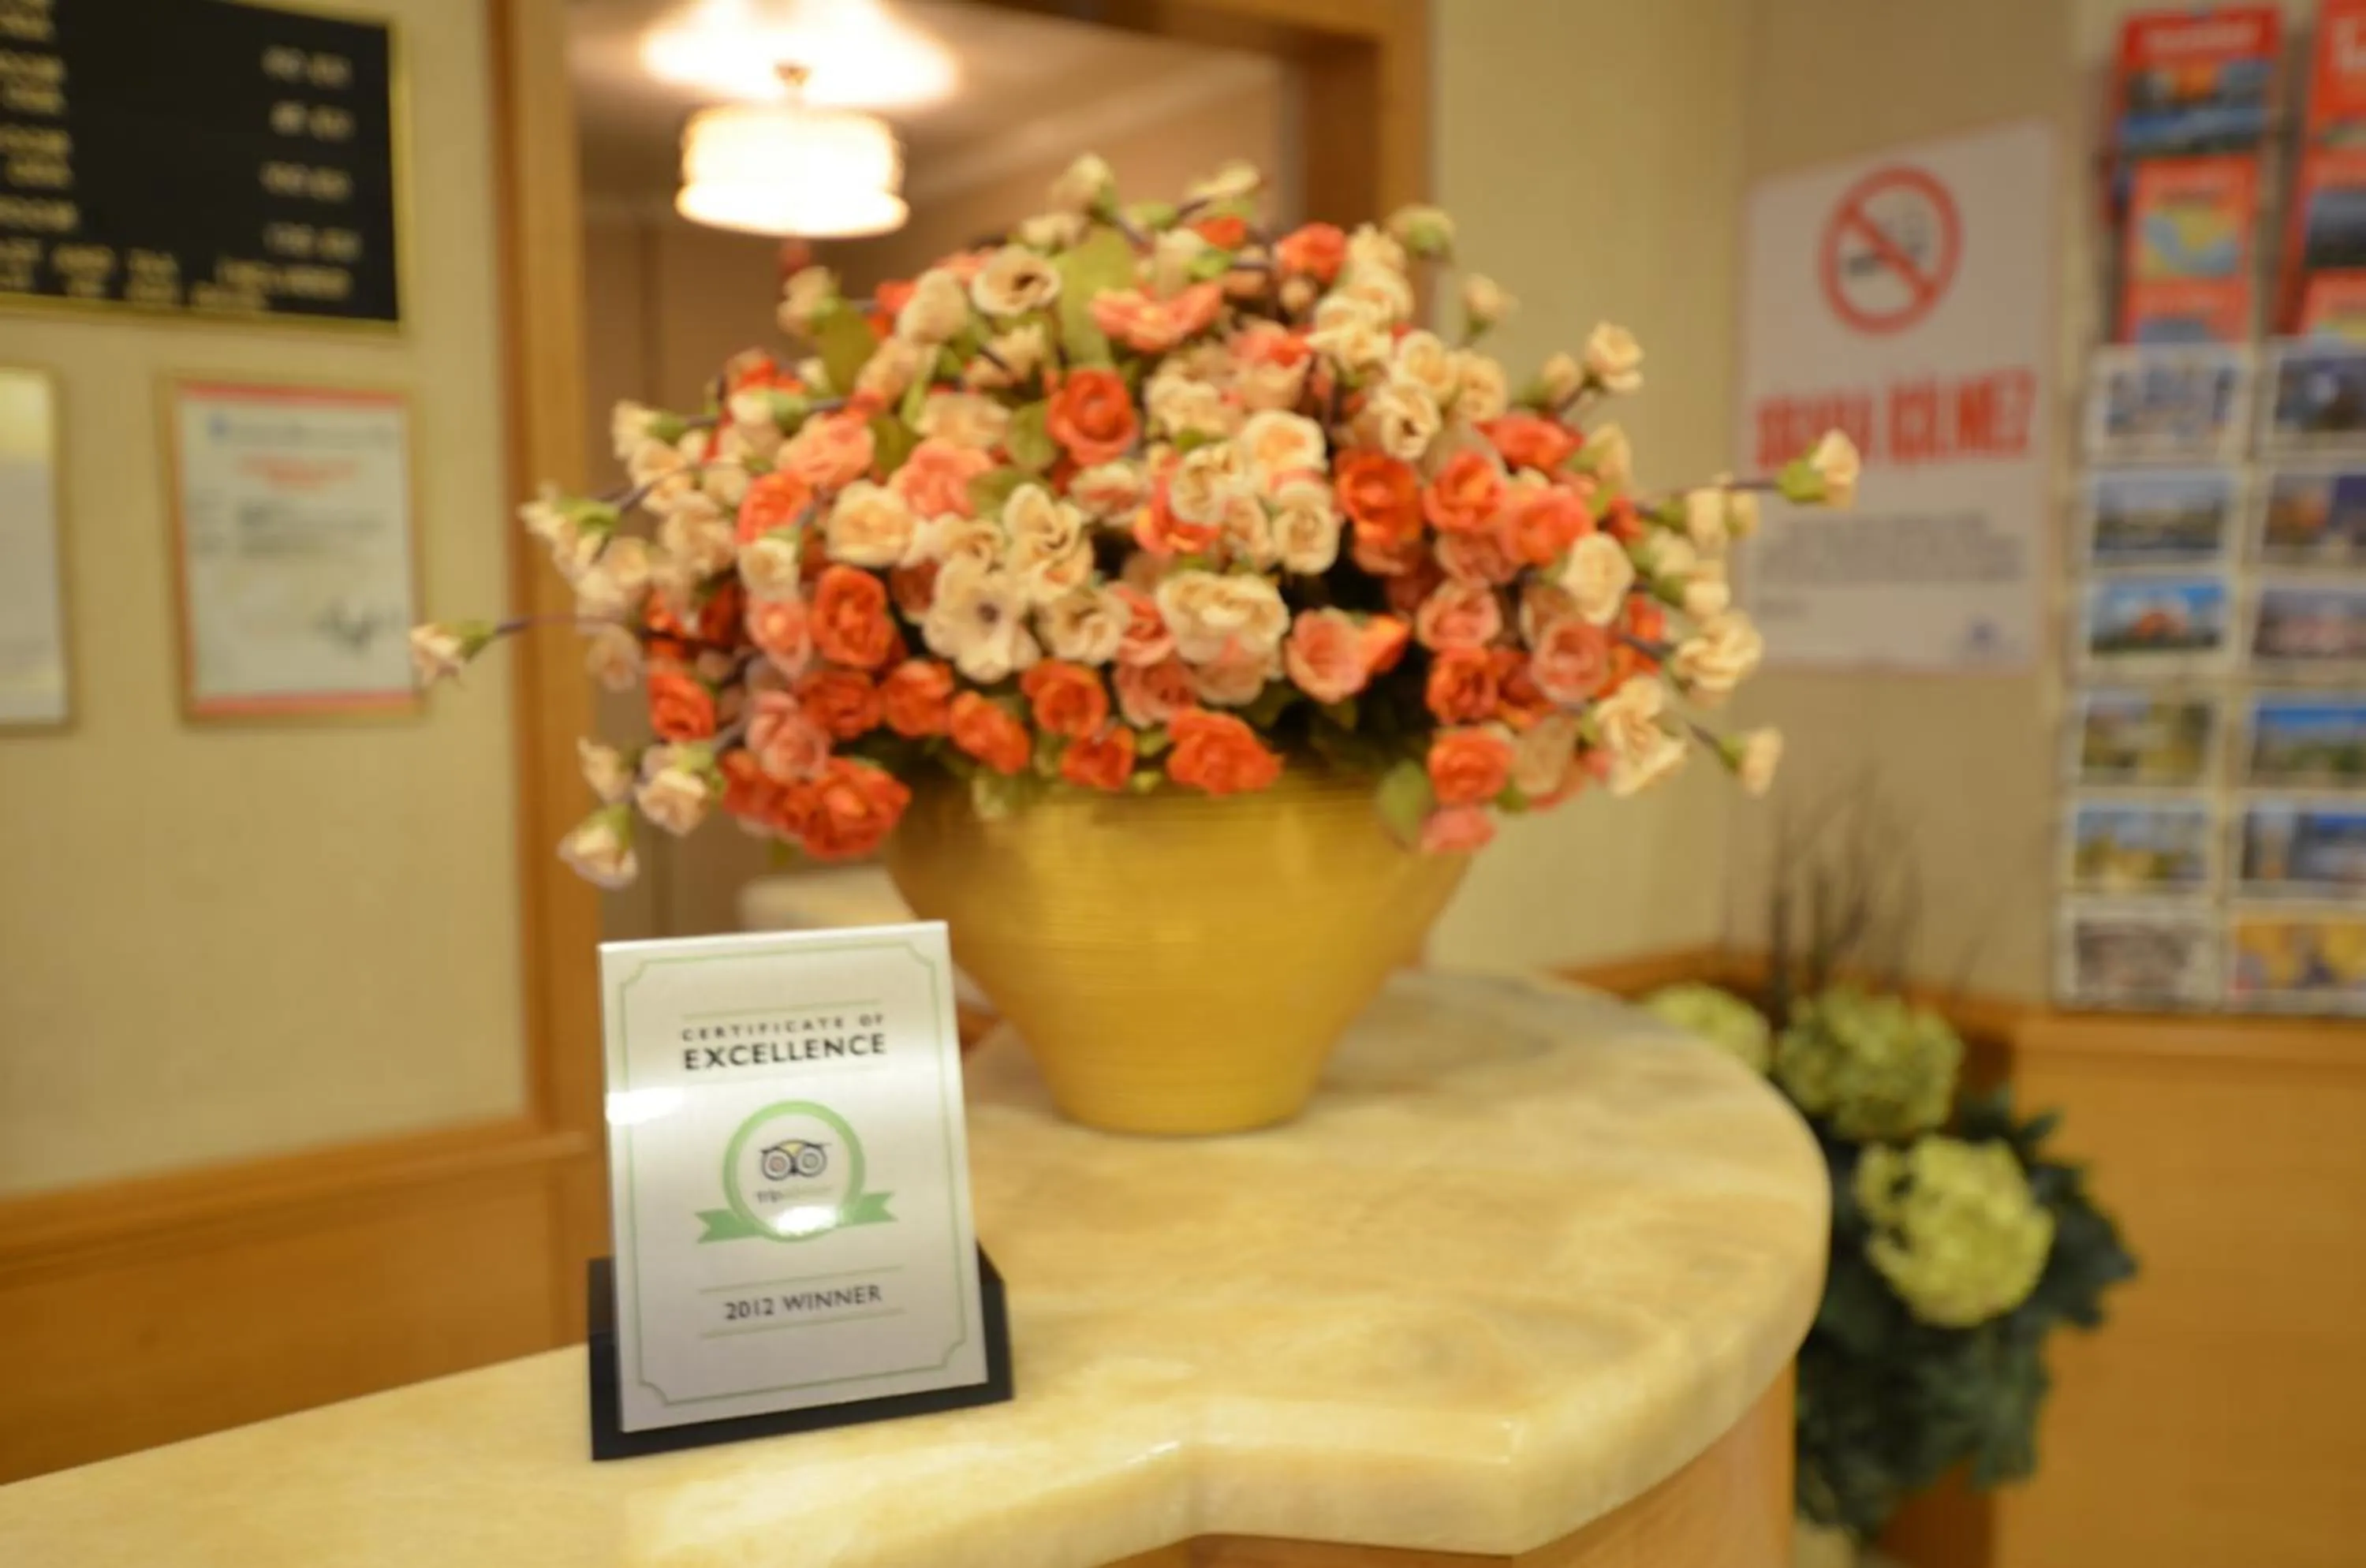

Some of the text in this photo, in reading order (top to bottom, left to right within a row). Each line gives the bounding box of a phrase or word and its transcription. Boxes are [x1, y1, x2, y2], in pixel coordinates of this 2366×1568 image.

[682, 1014, 884, 1041] CERTIFICATE OF
[684, 1033, 886, 1070] EXCELLENCE
[724, 1284, 882, 1320] 2012 WINNER
